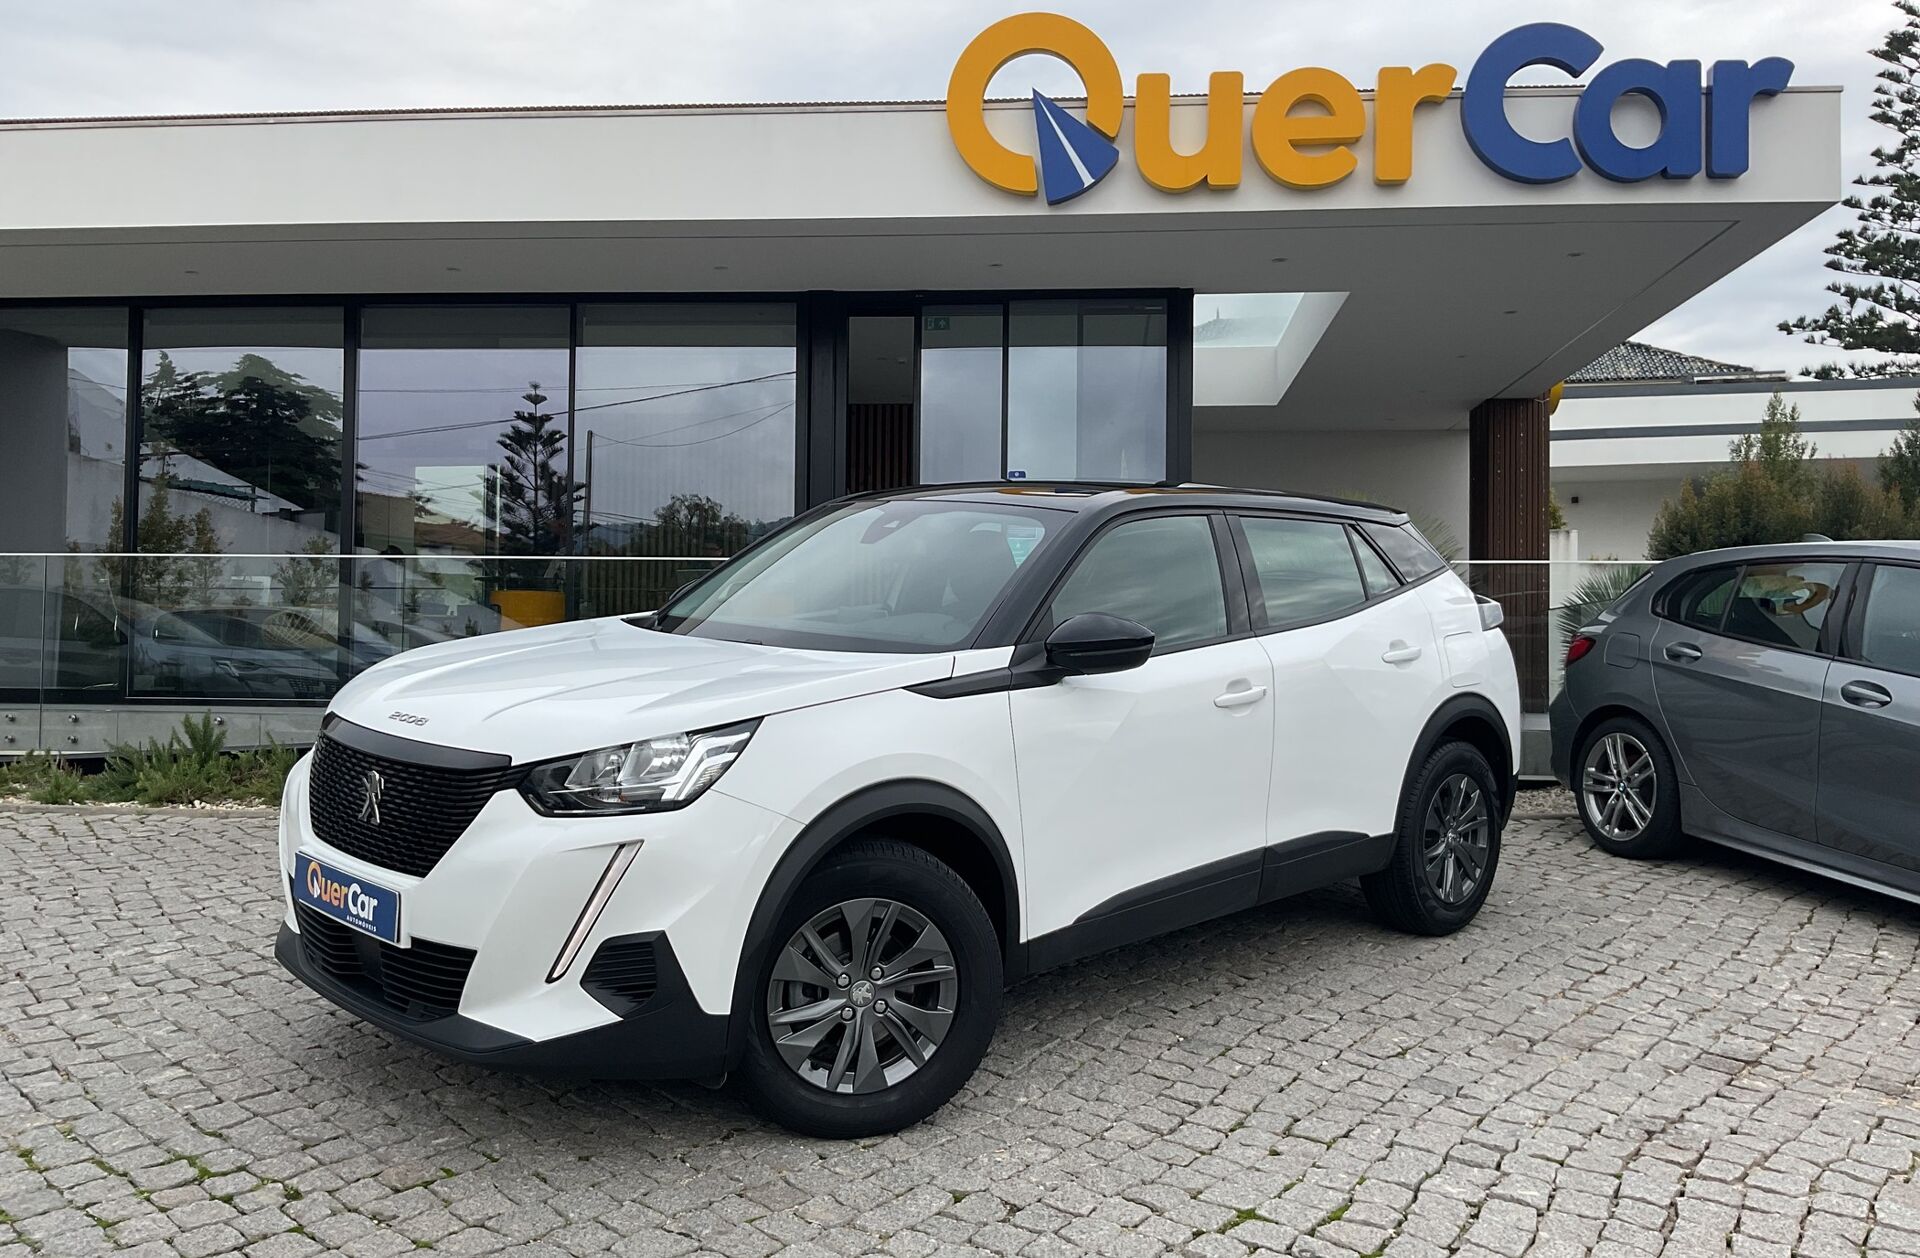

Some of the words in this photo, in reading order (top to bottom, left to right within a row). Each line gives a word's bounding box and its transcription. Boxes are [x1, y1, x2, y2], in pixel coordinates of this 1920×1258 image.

[946, 12, 1795, 205] QuerCar
[388, 711, 430, 727] 2008
[307, 861, 379, 921] QuerCar
